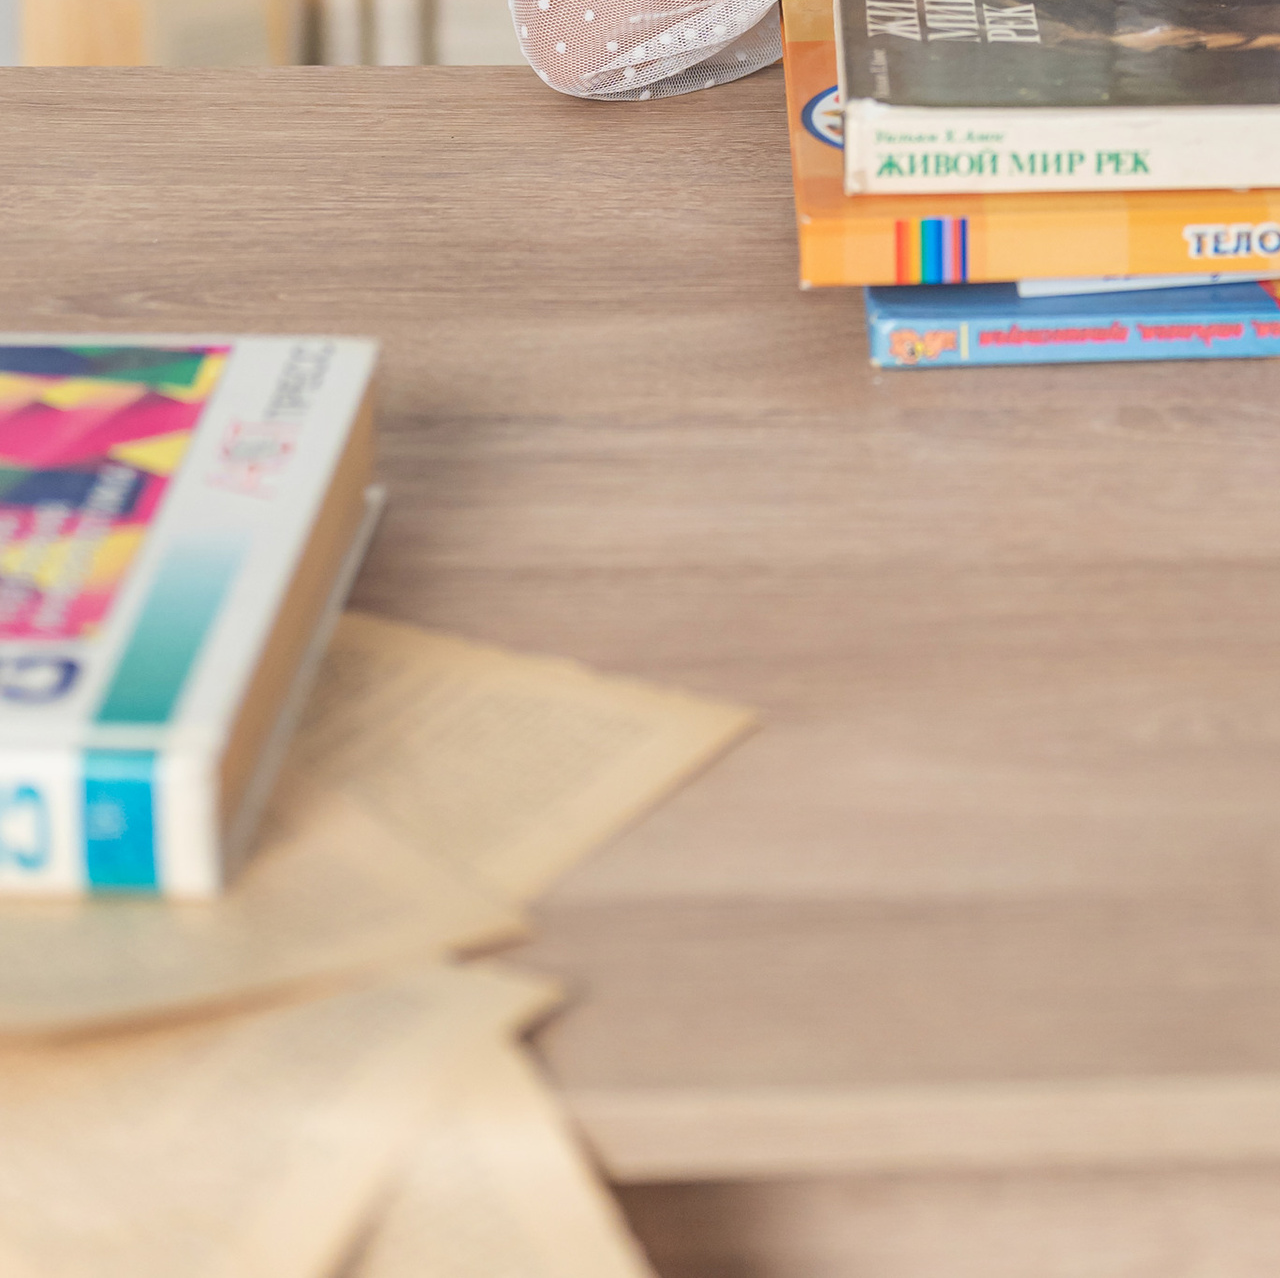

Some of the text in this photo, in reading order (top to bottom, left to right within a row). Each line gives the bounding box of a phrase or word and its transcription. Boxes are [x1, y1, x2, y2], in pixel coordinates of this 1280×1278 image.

[981, 2, 1042, 44] РЕК
[875, 147, 1151, 178] ЖИВОЙ МИР РЕК
